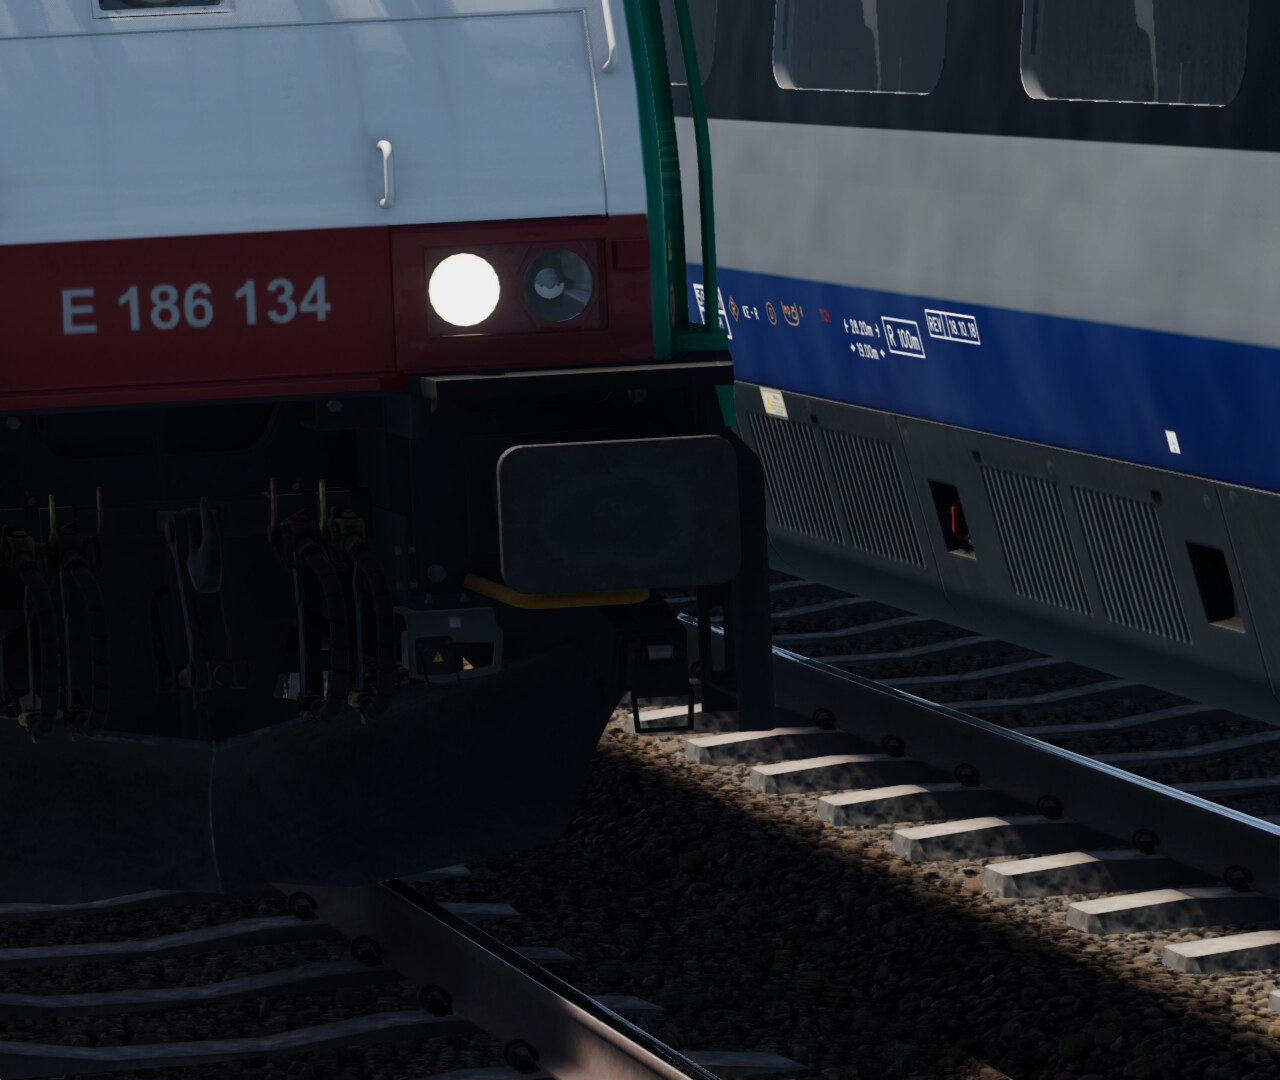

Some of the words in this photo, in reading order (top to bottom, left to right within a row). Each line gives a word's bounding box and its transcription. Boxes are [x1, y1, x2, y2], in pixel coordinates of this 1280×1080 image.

[61, 287, 98, 335] E
[118, 282, 214, 331] 186
[234, 275, 332, 325] 134
[886, 324, 897, 347] R
[896, 328, 921, 352] 100m
